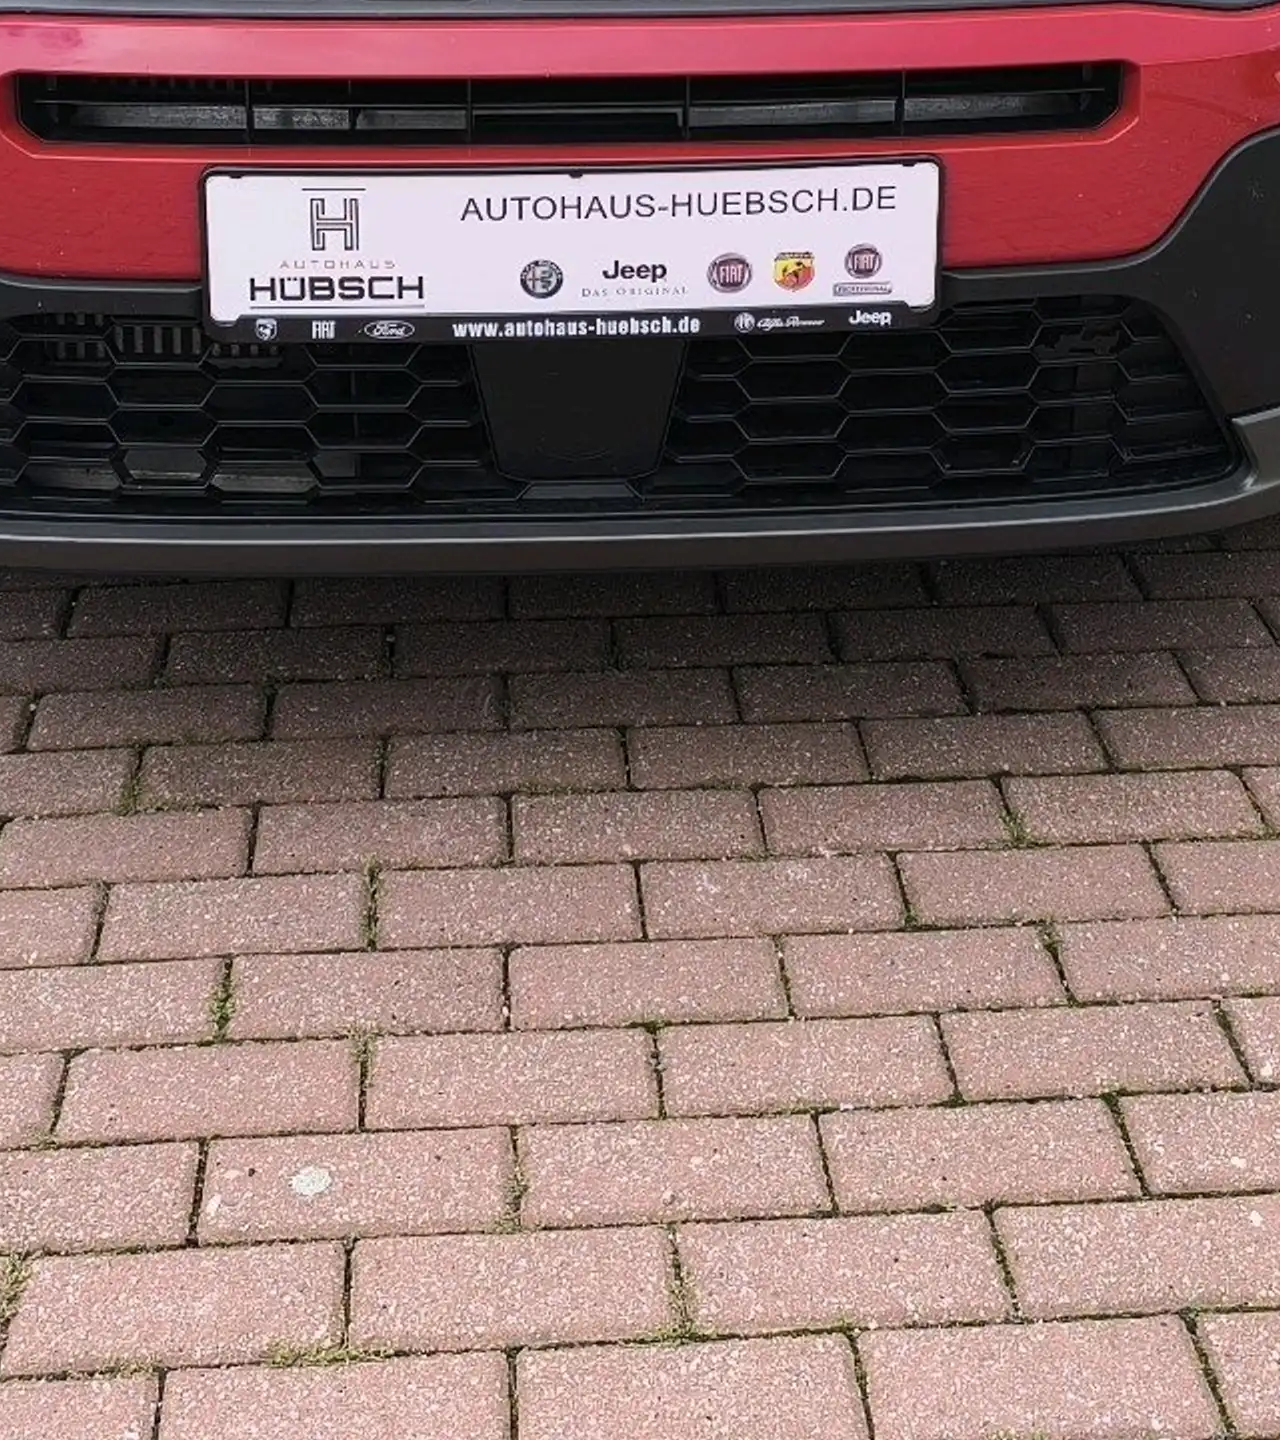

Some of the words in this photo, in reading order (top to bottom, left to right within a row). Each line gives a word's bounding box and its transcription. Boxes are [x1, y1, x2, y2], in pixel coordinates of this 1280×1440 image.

[460, 186, 897, 222] AUTOHAUS-HUEBSCH.DE
[280, 259, 397, 270] AUTOHAUS
[602, 260, 667, 283] Jeep
[719, 265, 744, 283] FIAT
[249, 276, 424, 302] HÜBSCH
[581, 288, 608, 298] DAS
[616, 286, 689, 297] ORIGINAL
[452, 316, 701, 338] www.autohaus-huebsch.de
[848, 310, 892, 327] Jeep
[373, 323, 405, 337] Ford
